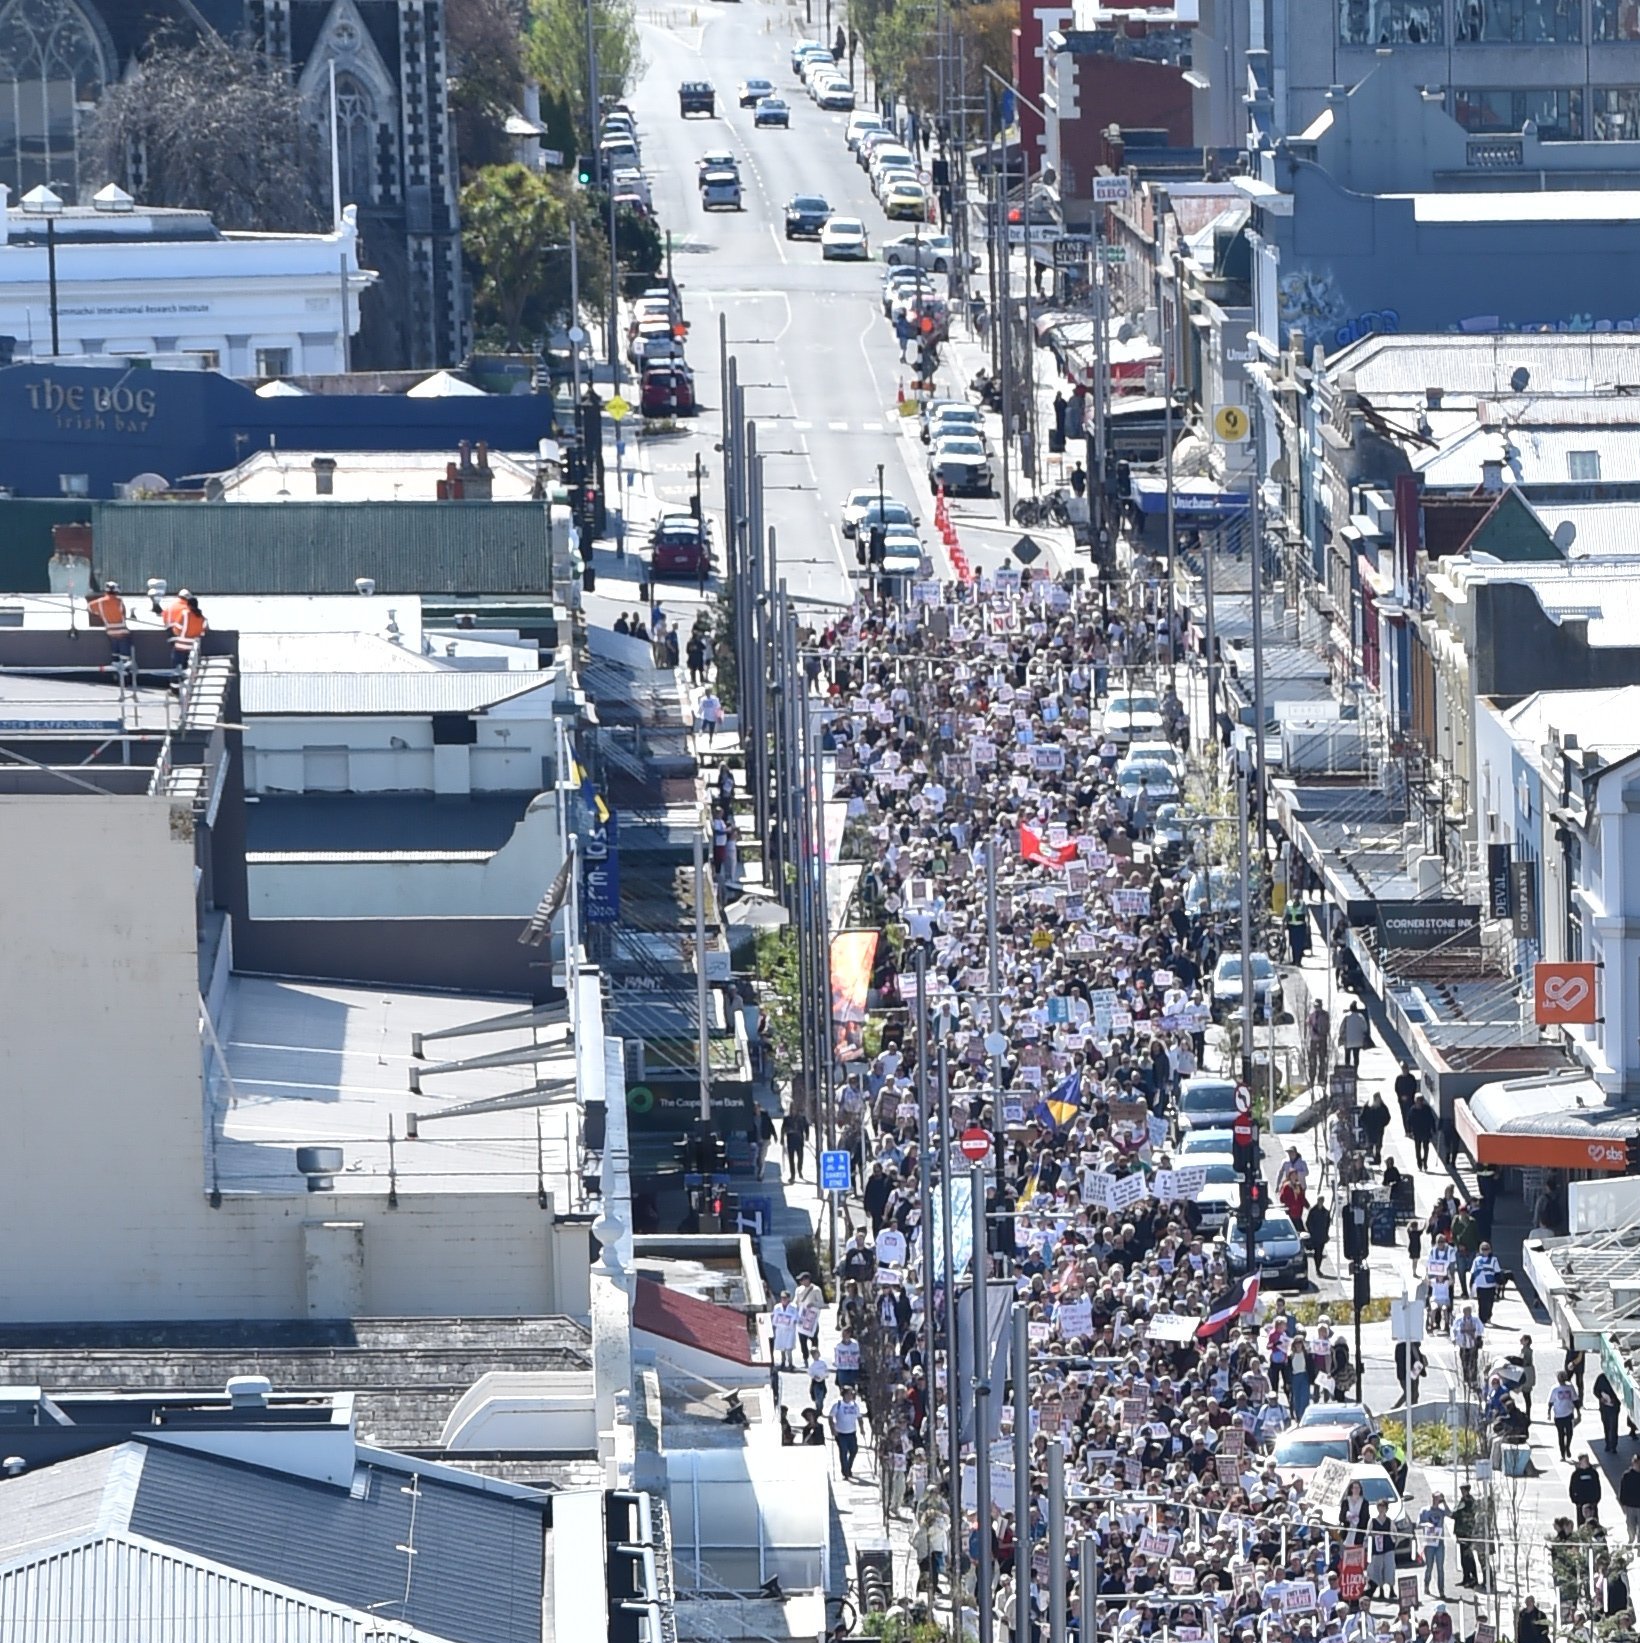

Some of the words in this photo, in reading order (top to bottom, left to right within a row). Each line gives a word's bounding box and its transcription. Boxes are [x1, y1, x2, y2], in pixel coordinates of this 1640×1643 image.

[1096, 189, 1128, 198] BBQ
[1056, 242, 1084, 251] LONE
[97, 305, 144, 314] International
[145, 304, 177, 313] Research
[178, 304, 209, 313] Institute
[56, 414, 106, 431] irish
[114, 414, 149, 432] bar
[28, 721, 104, 729] SCAFFOLDING
[1495, 873, 1507, 917] DEVAL
[1385, 918, 1455, 929] CORNERSTONE
[1457, 918, 1473, 928] INK
[660, 1098, 674, 1107] The
[725, 1098, 744, 1107] Bank
[1605, 1148, 1623, 1160] sbs
[1342, 1584, 1361, 1597] LIES
